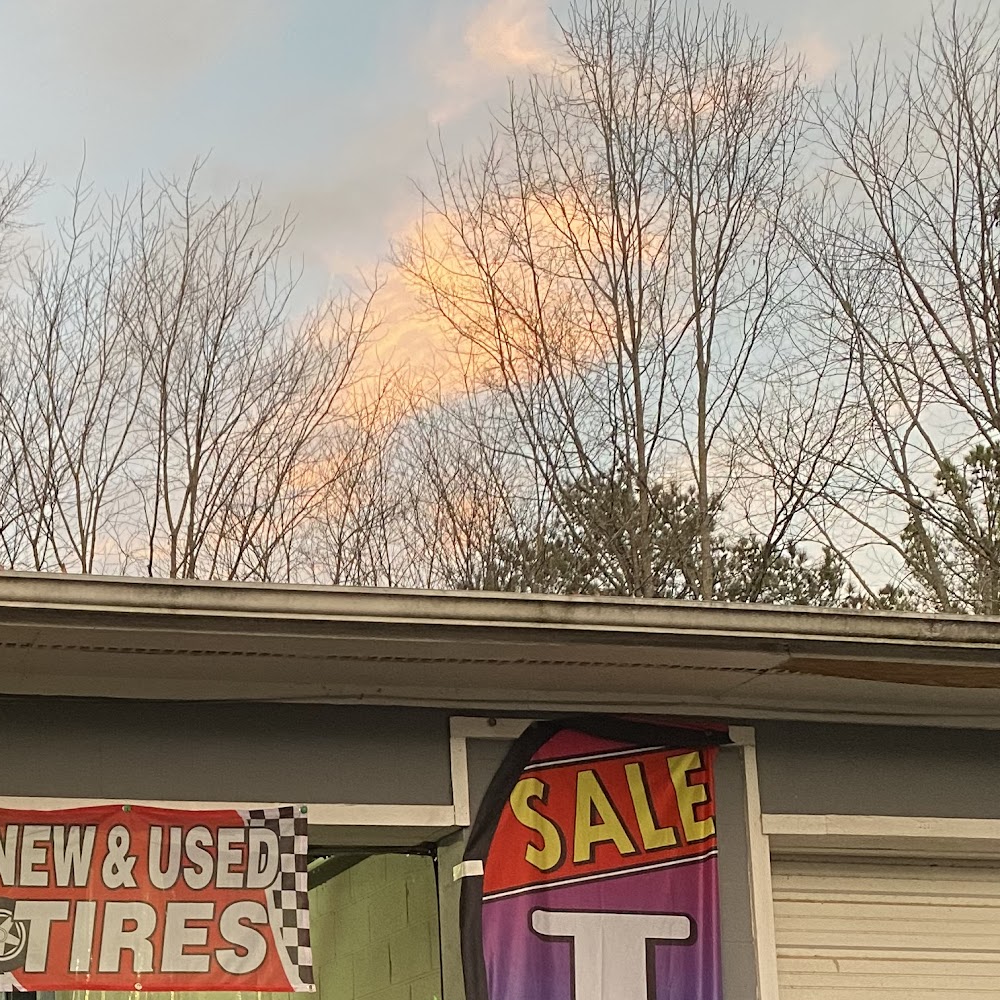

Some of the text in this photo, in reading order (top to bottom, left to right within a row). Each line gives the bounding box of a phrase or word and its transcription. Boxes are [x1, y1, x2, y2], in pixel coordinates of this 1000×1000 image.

[509, 750, 716, 871] SALE
[101, 823, 138, 890] &
[149, 824, 281, 891] USED
[12, 899, 270, 975] TIRES
